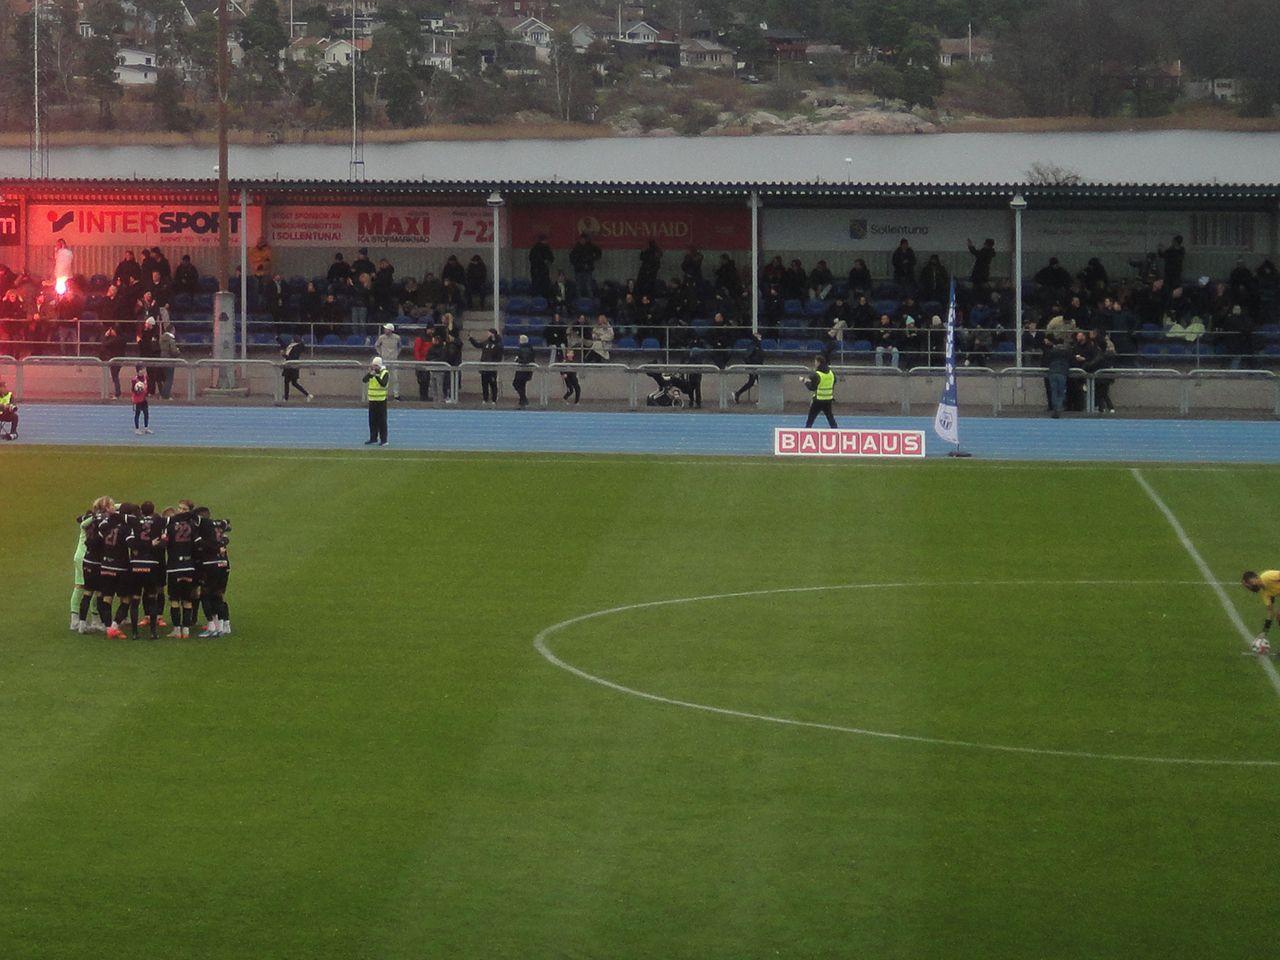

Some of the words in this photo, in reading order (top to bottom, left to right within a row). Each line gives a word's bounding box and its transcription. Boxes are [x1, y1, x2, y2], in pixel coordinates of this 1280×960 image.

[78, 211, 242, 234] INTERSPORT
[358, 211, 430, 235] MAXI
[870, 223, 929, 235] Sollentuna
[781, 433, 919, 451] BAUHAUS
